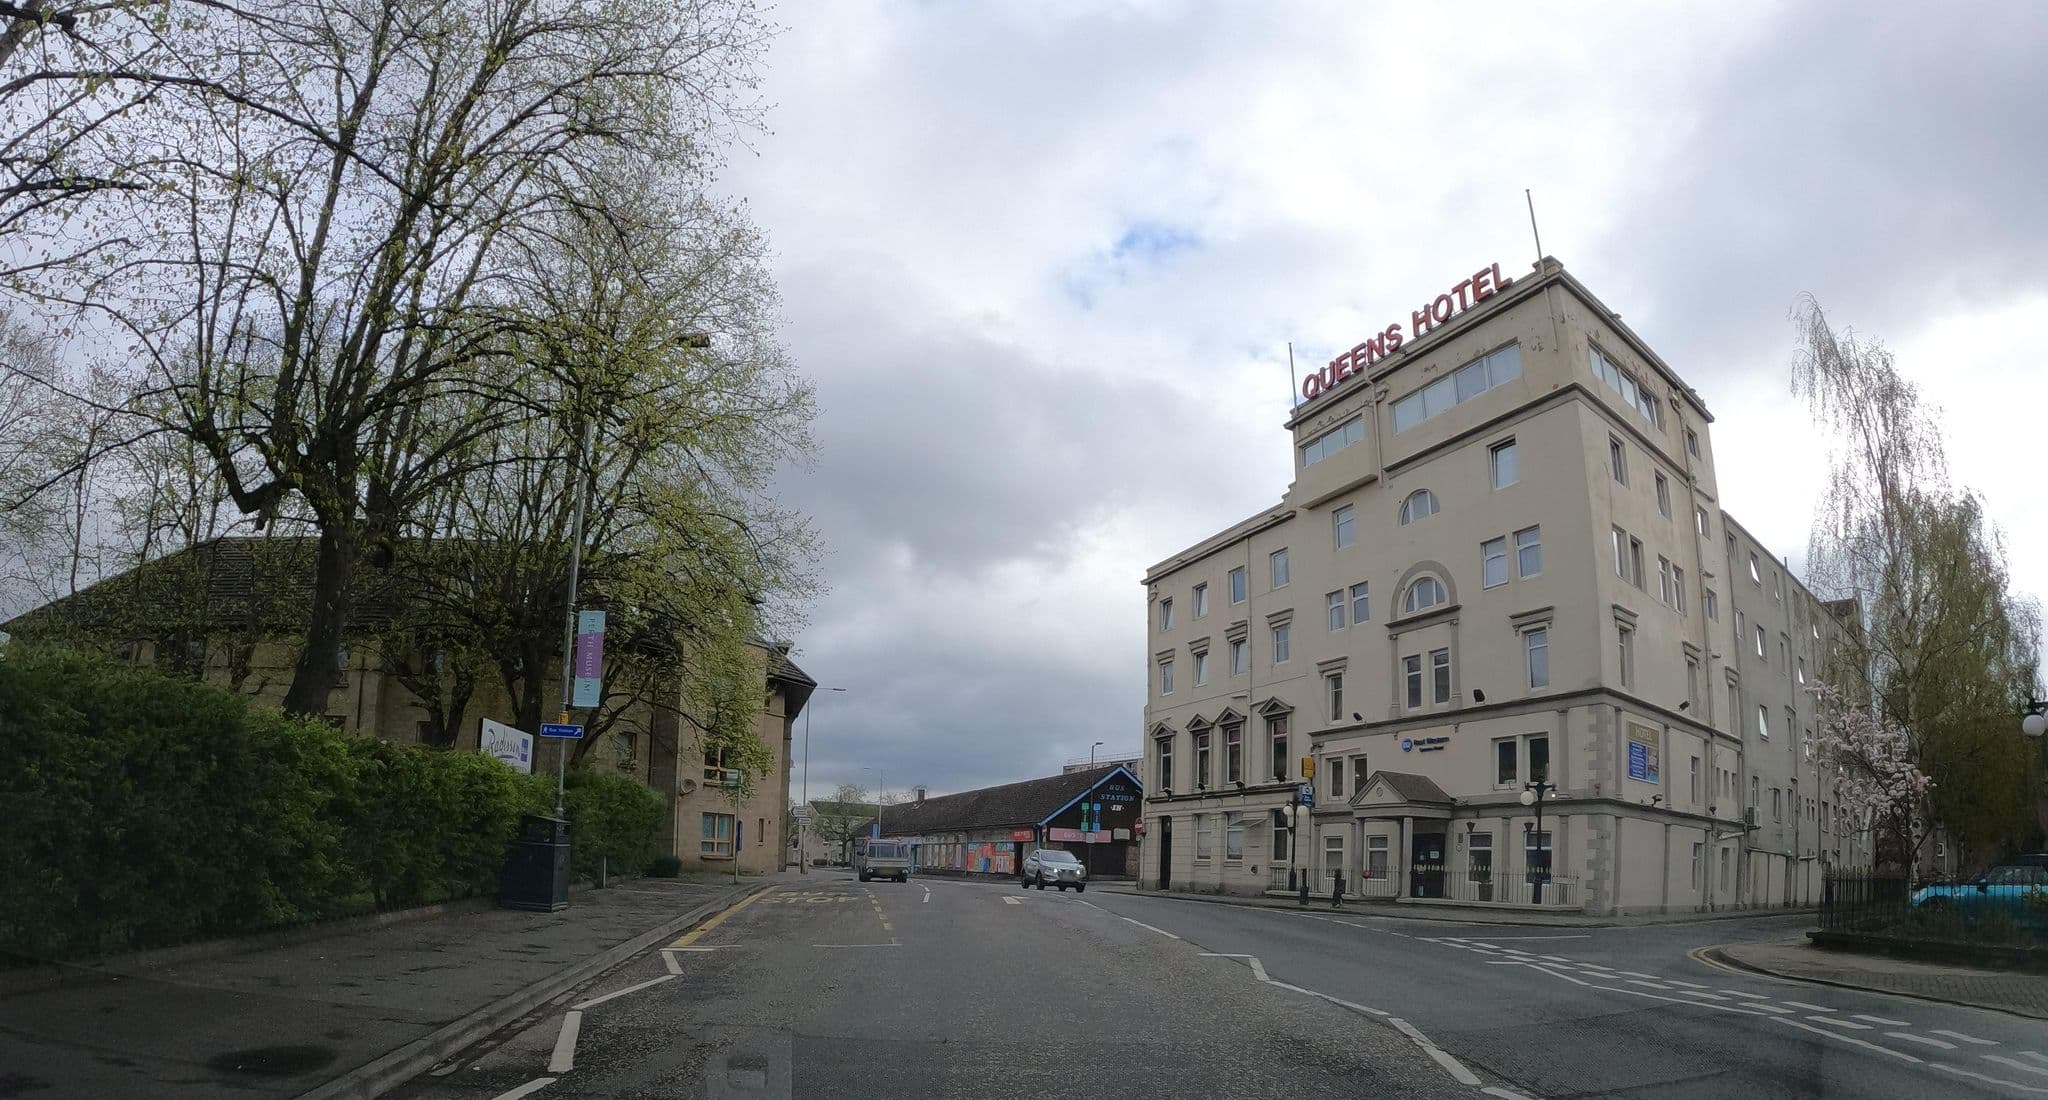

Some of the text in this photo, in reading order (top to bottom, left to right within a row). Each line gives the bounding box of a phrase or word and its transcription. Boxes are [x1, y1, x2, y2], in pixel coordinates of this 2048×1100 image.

[1303, 262, 1513, 400] QUEENS HOTEL
[583, 618, 596, 692] PERTH MUSEUM
[1100, 793, 1136, 801] STATION
